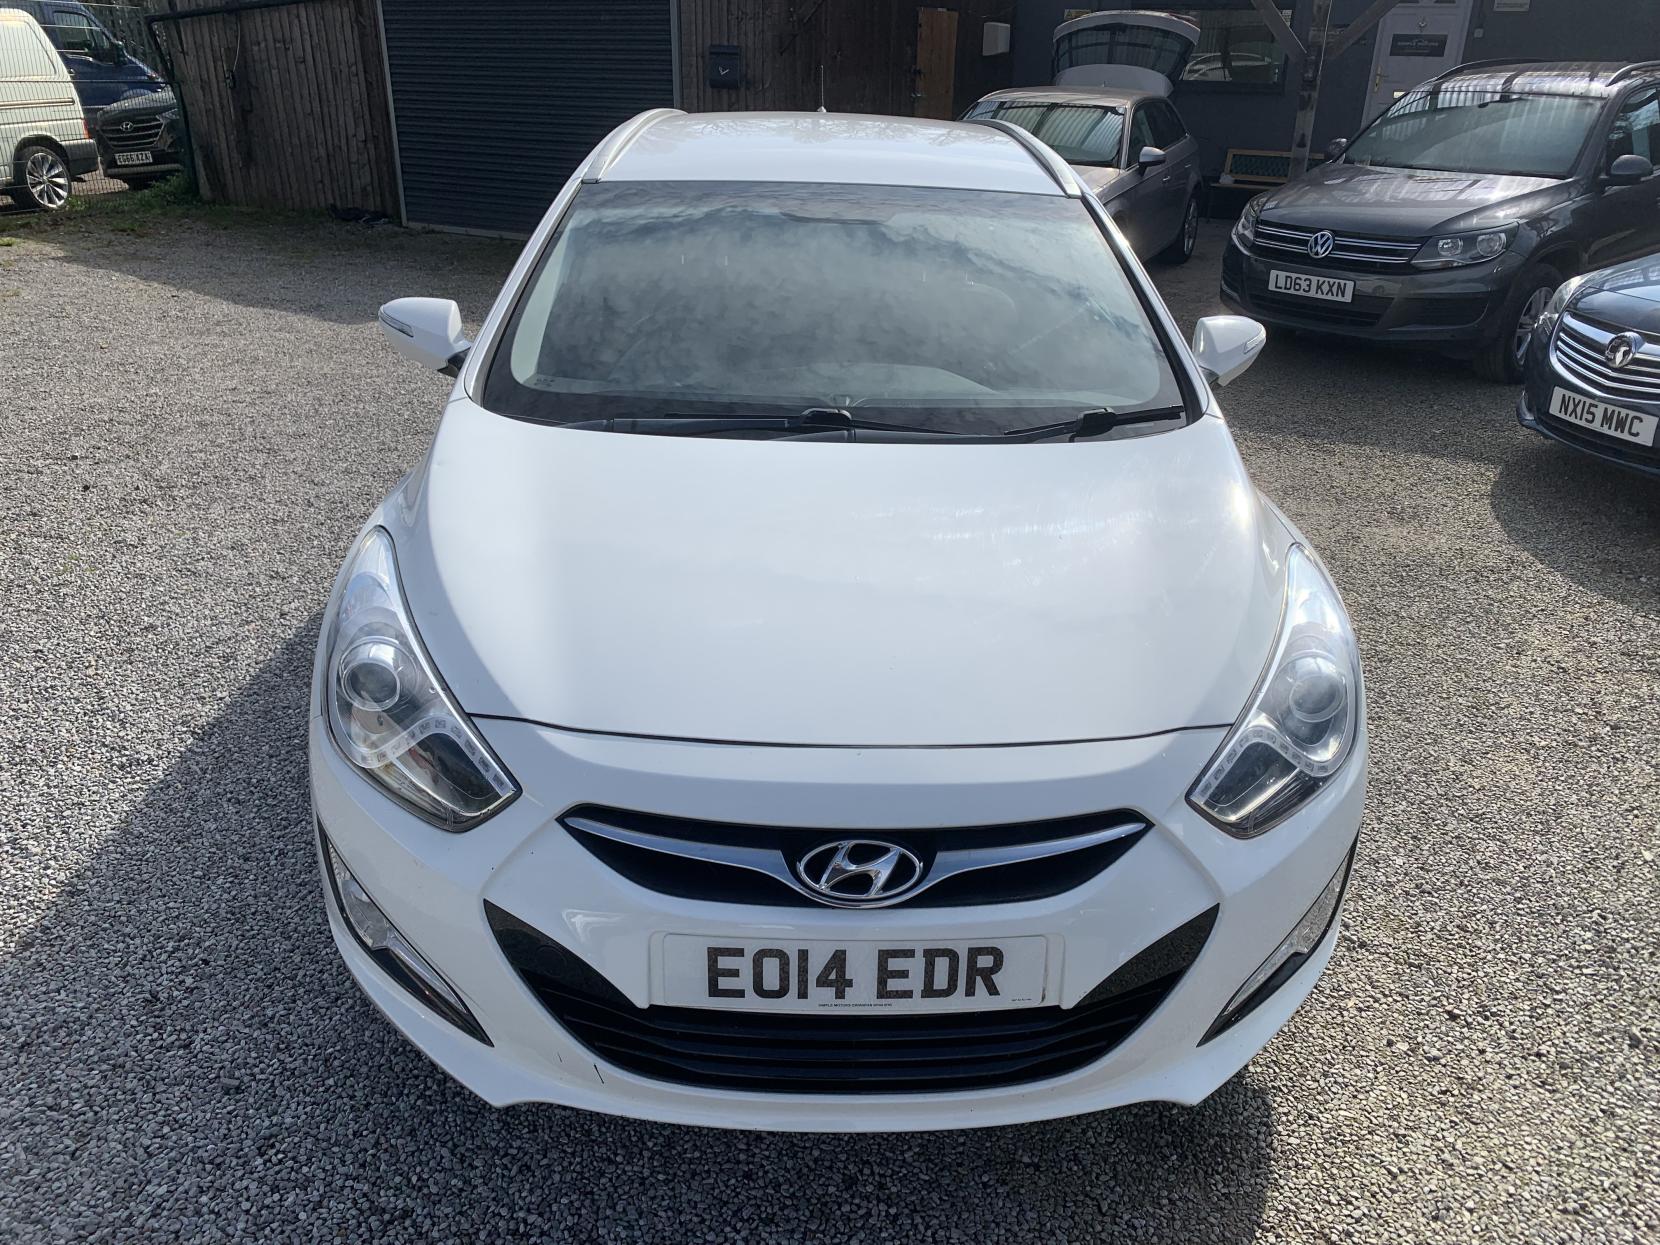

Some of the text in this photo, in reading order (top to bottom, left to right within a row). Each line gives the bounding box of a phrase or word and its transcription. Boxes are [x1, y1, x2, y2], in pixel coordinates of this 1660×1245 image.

[1274, 273, 1347, 298] LD63 KXN
[1558, 394, 1643, 438] NX15 MWC
[706, 946, 1005, 1000] EO14 EDR
